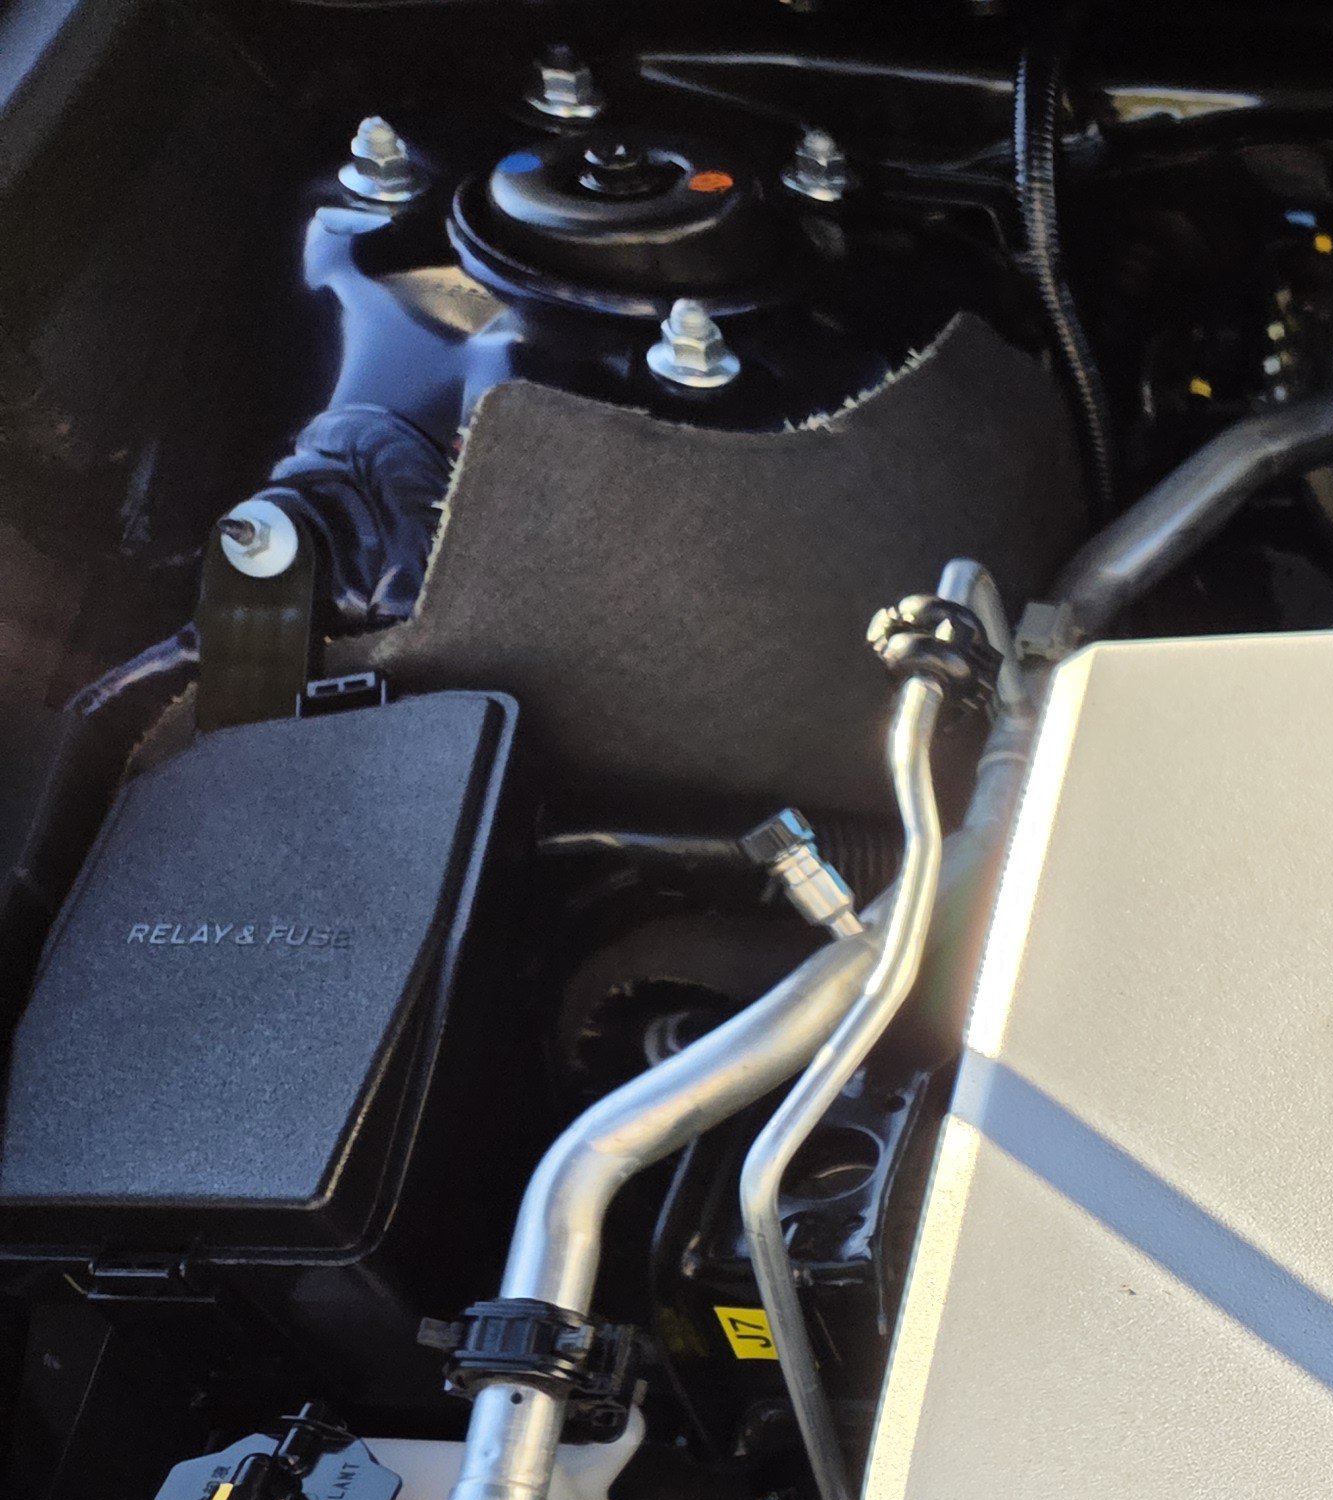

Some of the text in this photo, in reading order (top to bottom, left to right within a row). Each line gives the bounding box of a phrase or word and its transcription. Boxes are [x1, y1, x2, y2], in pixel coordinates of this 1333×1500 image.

[126, 922, 234, 945] RELAY
[265, 924, 355, 949] FUSE
[727, 1317, 772, 1348] J7
